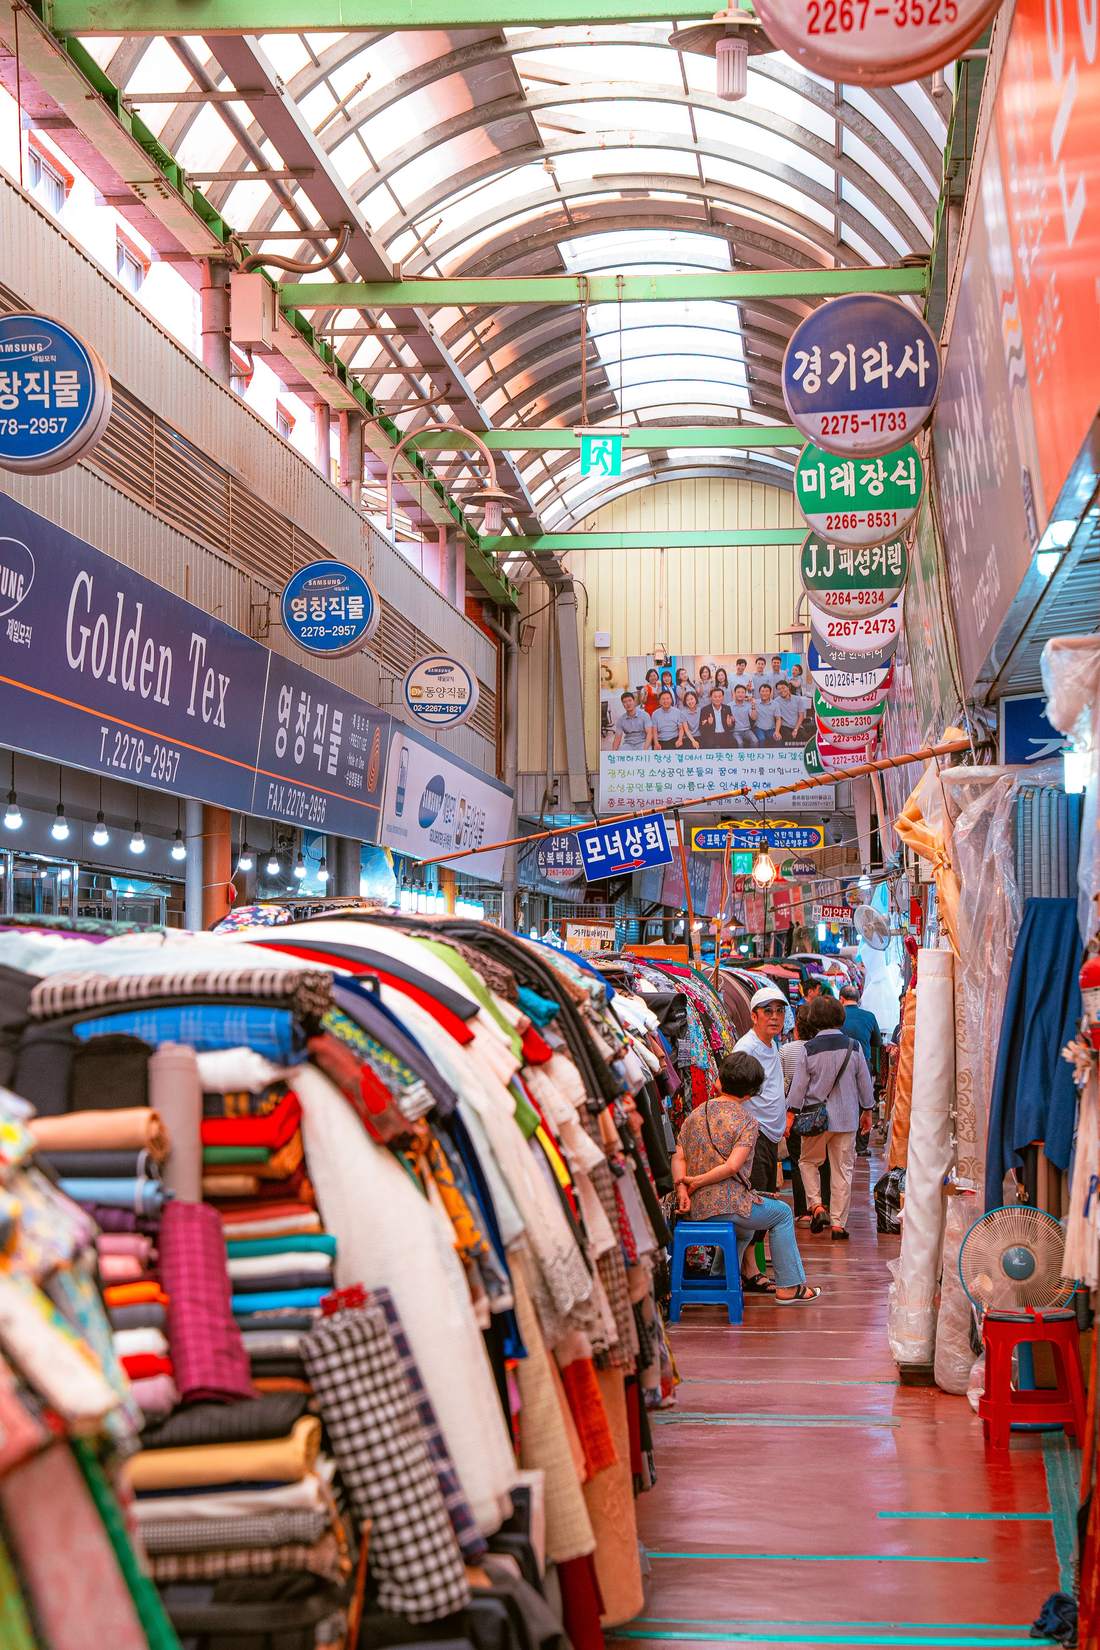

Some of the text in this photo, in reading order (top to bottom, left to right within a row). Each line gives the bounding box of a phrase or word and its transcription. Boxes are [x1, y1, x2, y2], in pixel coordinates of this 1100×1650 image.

[807, 0, 957, 35] 2267-3525
[792, 339, 931, 394] 경기라사
[821, 411, 907, 435] 2275-1733
[800, 457, 916, 499] 미래장식
[826, 512, 897, 530] 2266-8531
[291, 596, 364, 621] 영창직물
[825, 591, 885, 606] 2264-9234
[6, 618, 33, 648] 제일모직
[301, 625, 356, 637] 2278-2957
[828, 619, 896, 637] 2267-2473
[66, 570, 231, 728] Golden Tex
[824, 672, 877, 687] 02)2264-4171
[425, 686, 467, 699] 동양직물
[413, 704, 462, 713] 02-2267-1821
[275, 684, 343, 775] 영창직물
[832, 716, 871, 727] 2285-2310
[99, 727, 181, 783] T.2278-2957
[832, 755, 867, 765] 2272-5346
[267, 782, 327, 824] FAX.2278-2956
[551, 837, 569, 851] 신라
[586, 821, 664, 863] 모녀상회
